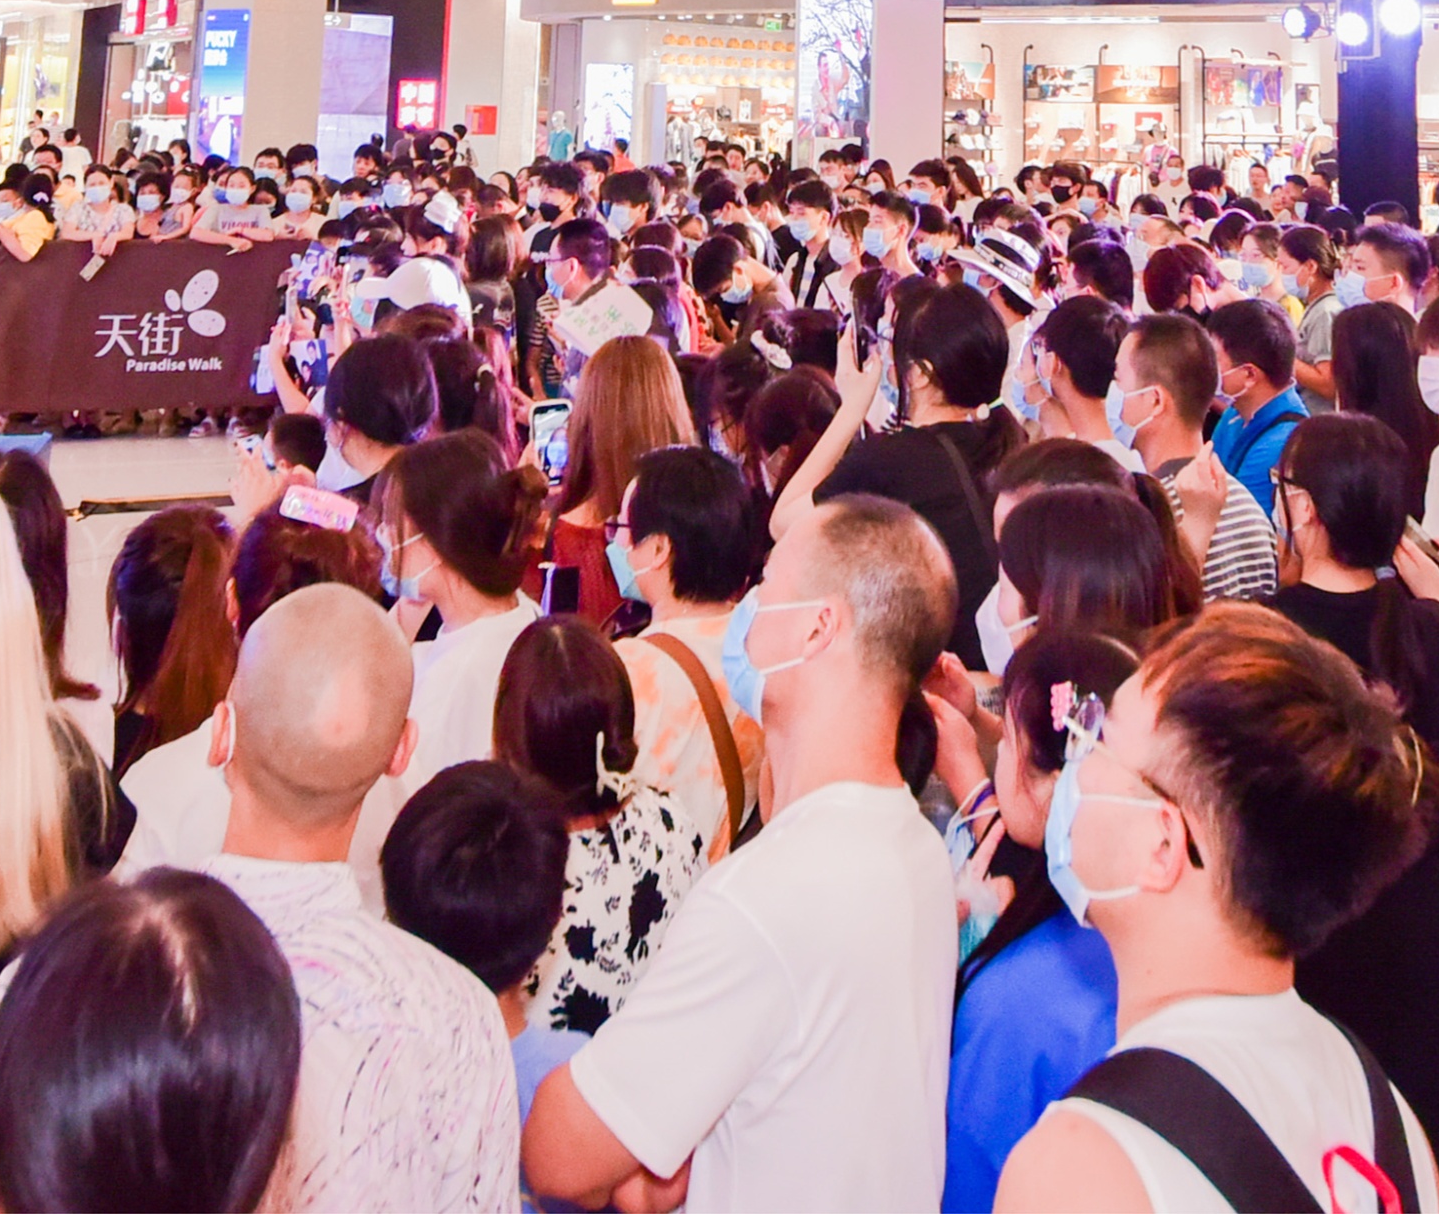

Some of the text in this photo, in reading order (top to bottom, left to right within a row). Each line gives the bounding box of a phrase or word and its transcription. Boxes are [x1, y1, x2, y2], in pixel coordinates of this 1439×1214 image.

[94, 312, 184, 358] 天街
[126, 357, 223, 372] Paradise Walk
